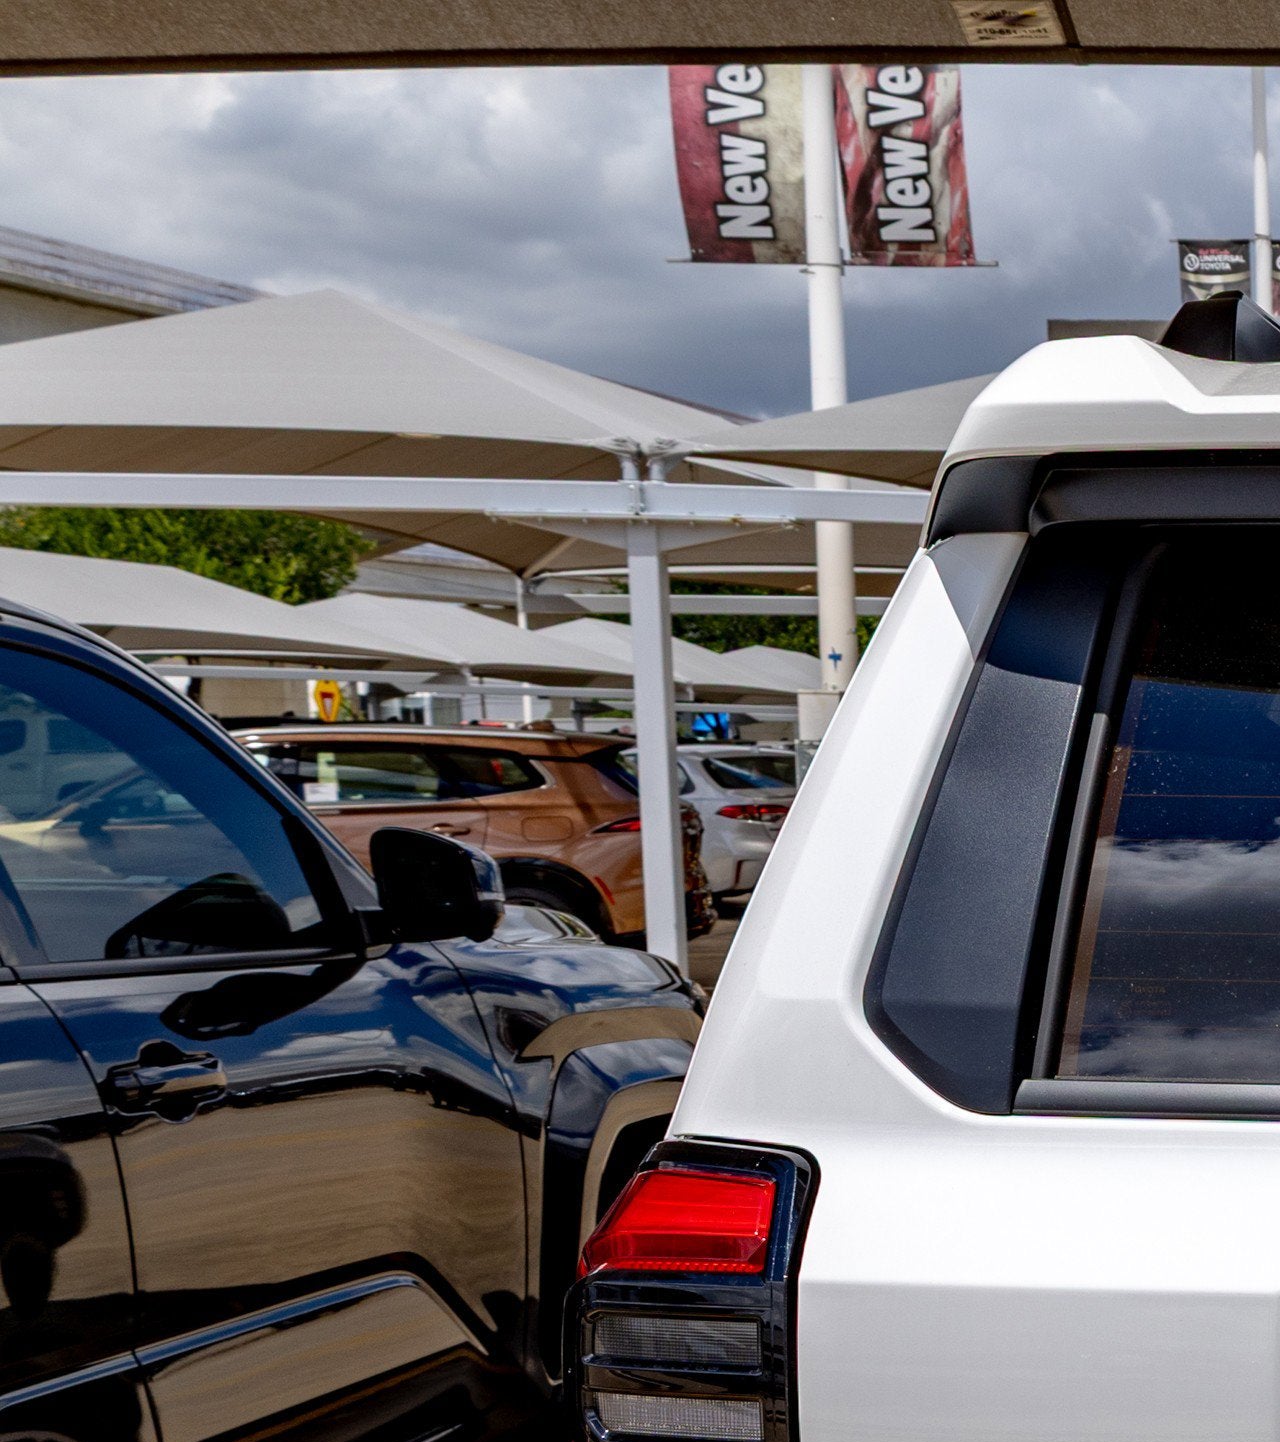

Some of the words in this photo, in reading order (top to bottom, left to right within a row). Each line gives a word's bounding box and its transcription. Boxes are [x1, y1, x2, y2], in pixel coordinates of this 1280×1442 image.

[716, 133, 775, 240] New
[876, 136, 937, 243] New
[1199, 262, 1232, 271] TOYOTA
